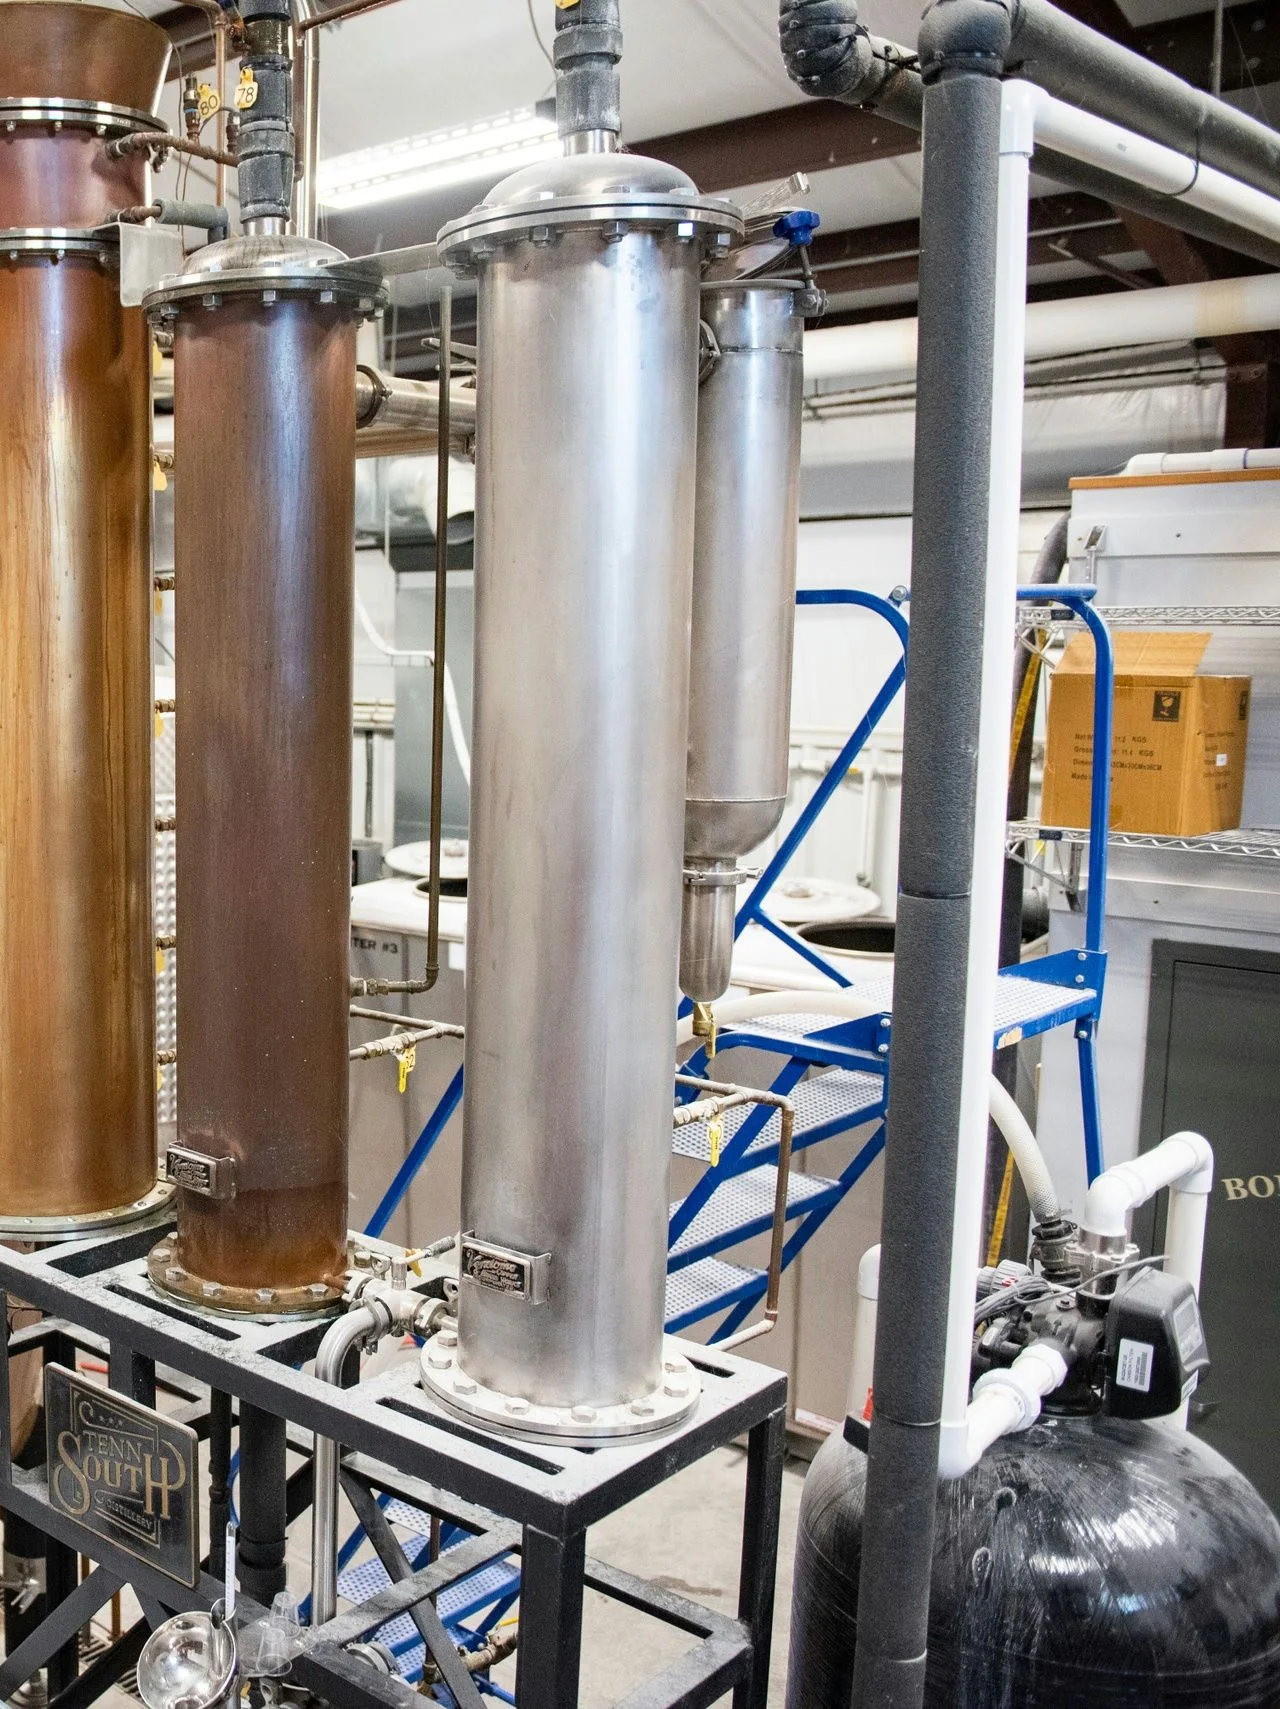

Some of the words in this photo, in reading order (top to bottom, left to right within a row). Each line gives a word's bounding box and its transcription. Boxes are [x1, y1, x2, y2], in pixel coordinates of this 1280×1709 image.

[200, 95, 218, 115] 80
[236, 87, 254, 106] 78
[1221, 1174, 1280, 1200] BO
[83, 1431, 142, 1463] TENN
[54, 1431, 186, 1520] SOUTH
